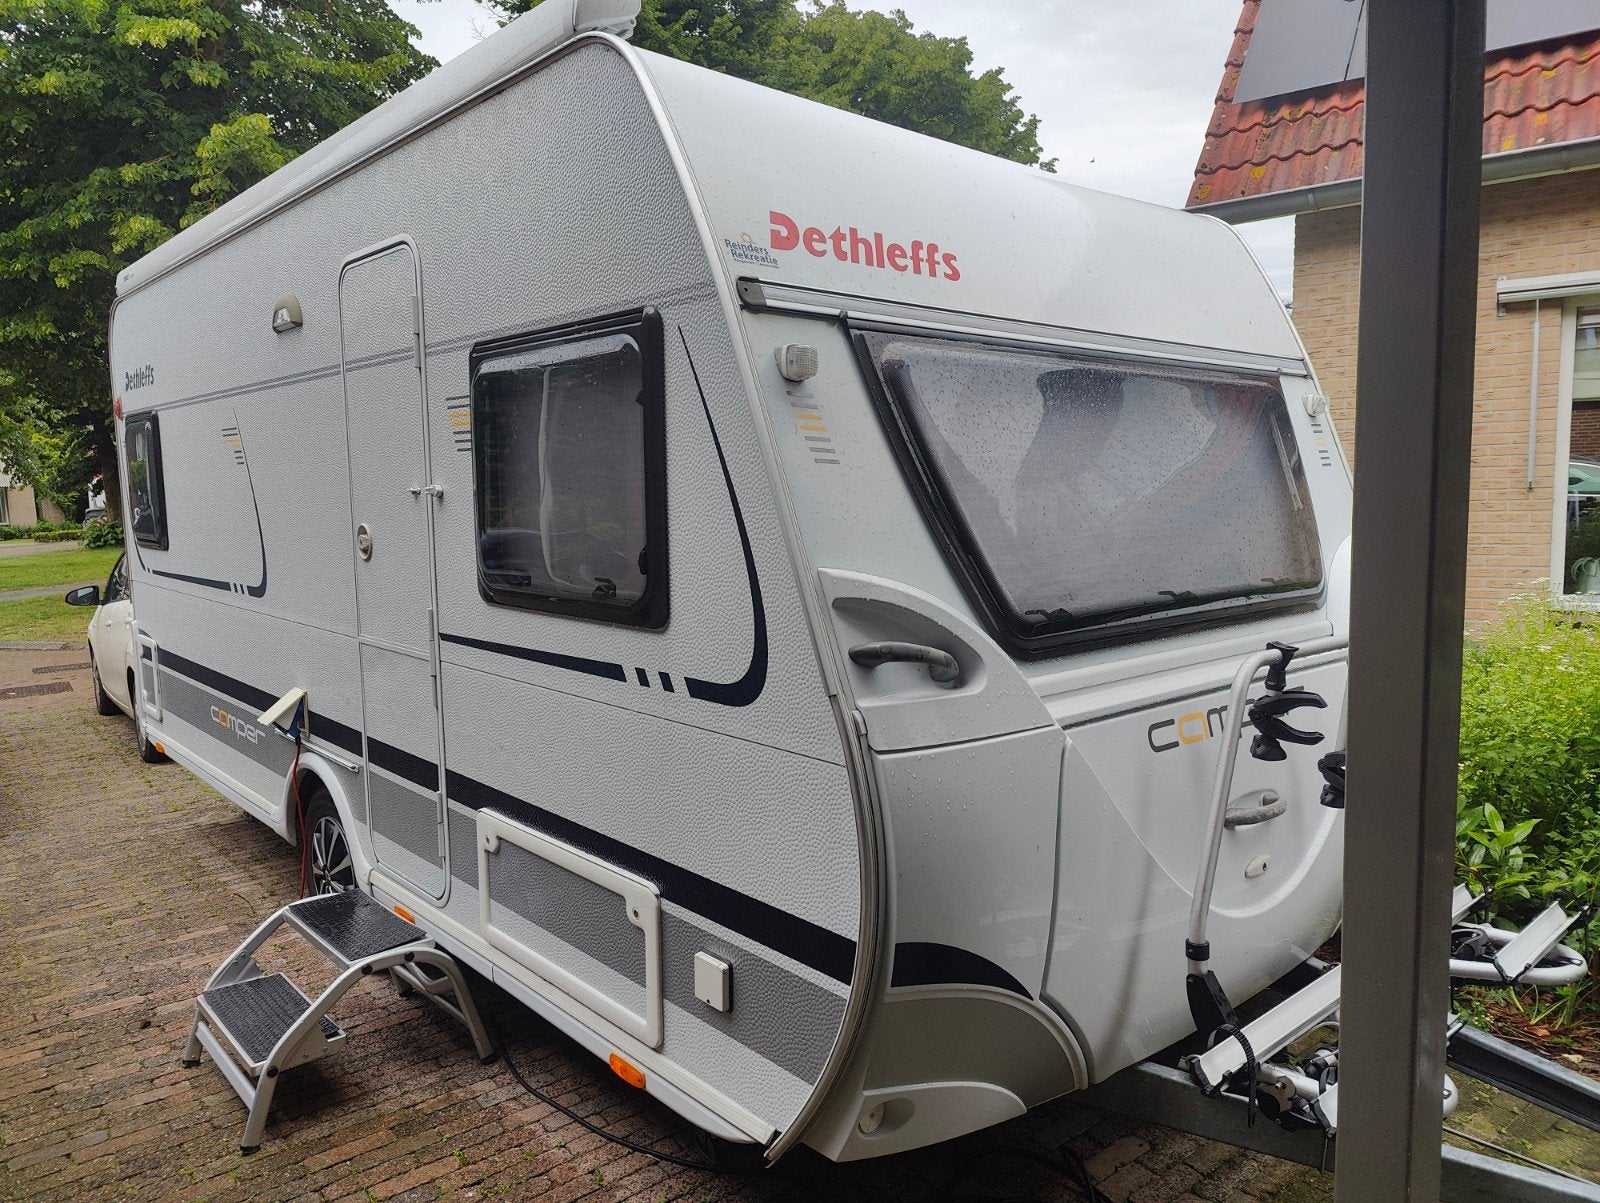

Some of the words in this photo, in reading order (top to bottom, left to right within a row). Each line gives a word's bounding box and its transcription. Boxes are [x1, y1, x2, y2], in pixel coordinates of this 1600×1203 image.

[724, 239, 769, 255] Reinders
[730, 248, 779, 265] Rekreatie
[770, 210, 961, 281] Dethleffs
[125, 363, 155, 392] Dethleffs
[210, 705, 266, 745] camper
[1147, 685, 1305, 753] cam
